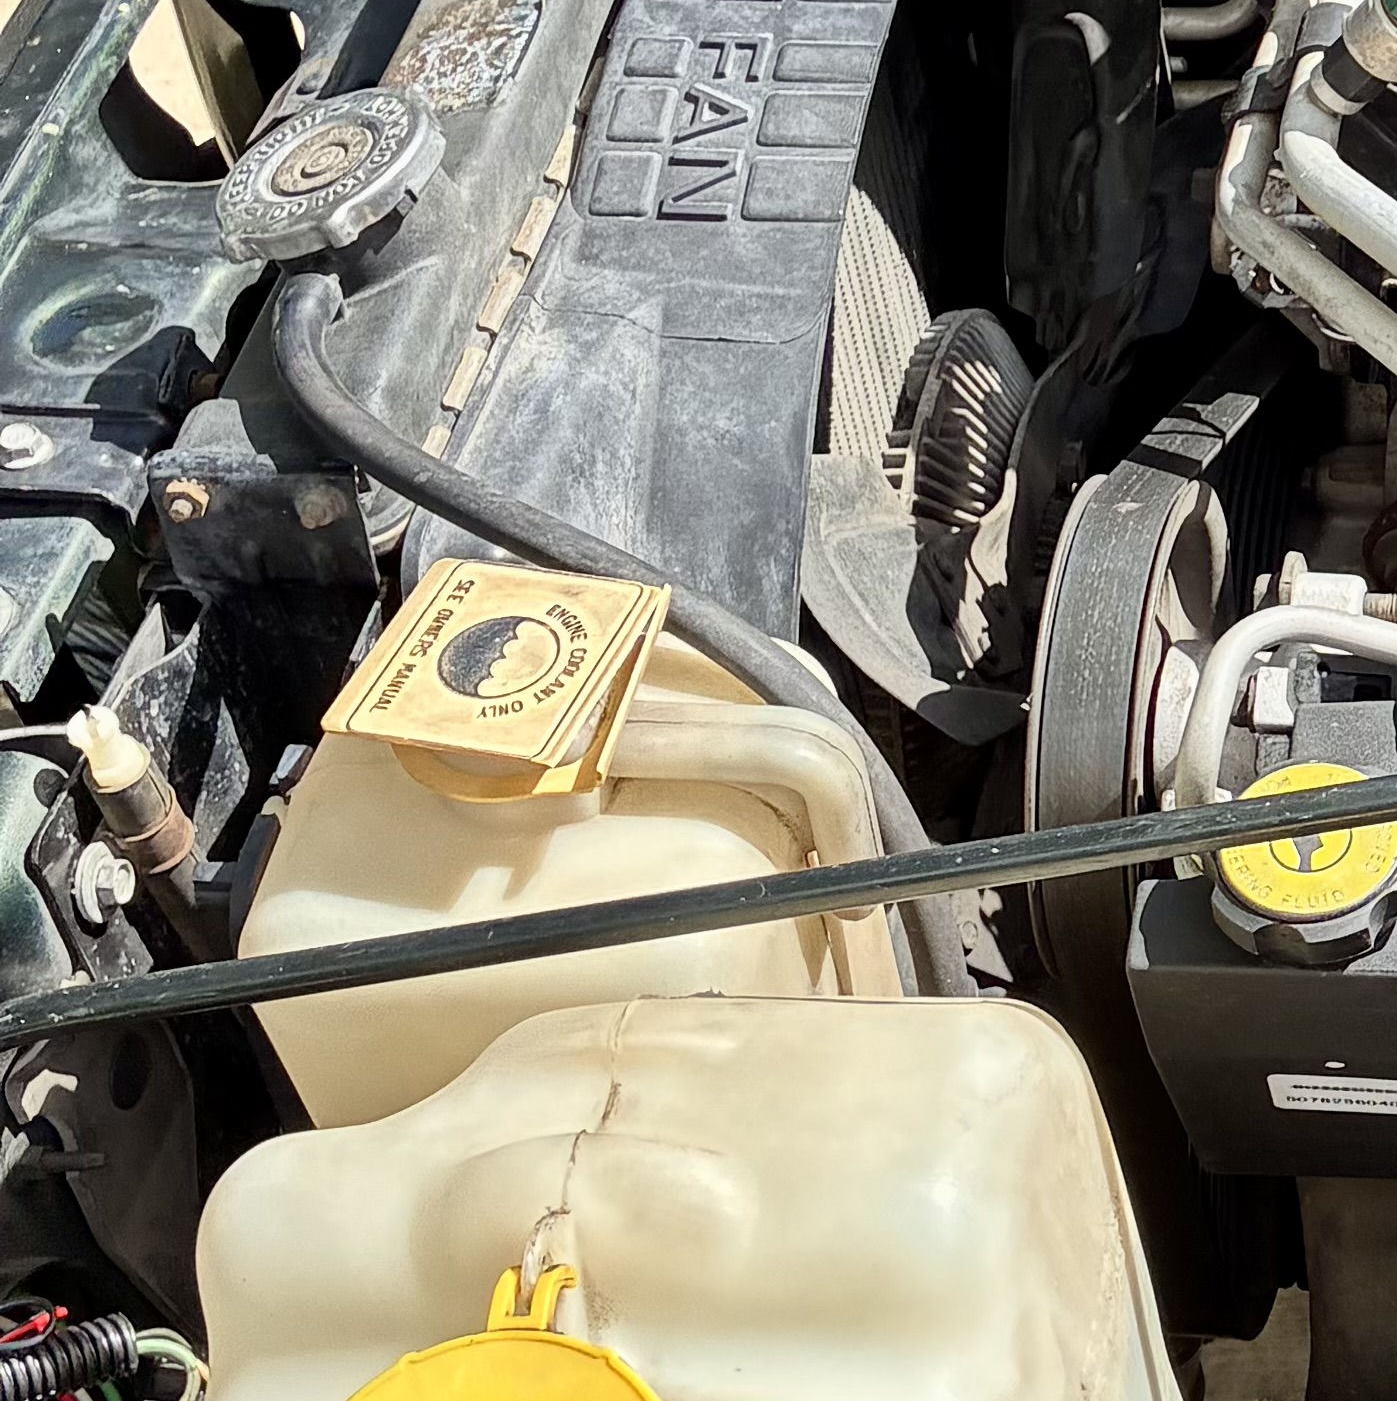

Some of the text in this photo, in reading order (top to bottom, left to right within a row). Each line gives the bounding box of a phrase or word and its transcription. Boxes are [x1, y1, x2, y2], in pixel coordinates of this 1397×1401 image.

[657, 33, 773, 222] FAN
[446, 579, 475, 604] SEE
[476, 604, 588, 719] ENGINE COOLANT ONLY
[369, 662, 417, 713] MANUAL
[1282, 889, 1345, 909] FLUID
